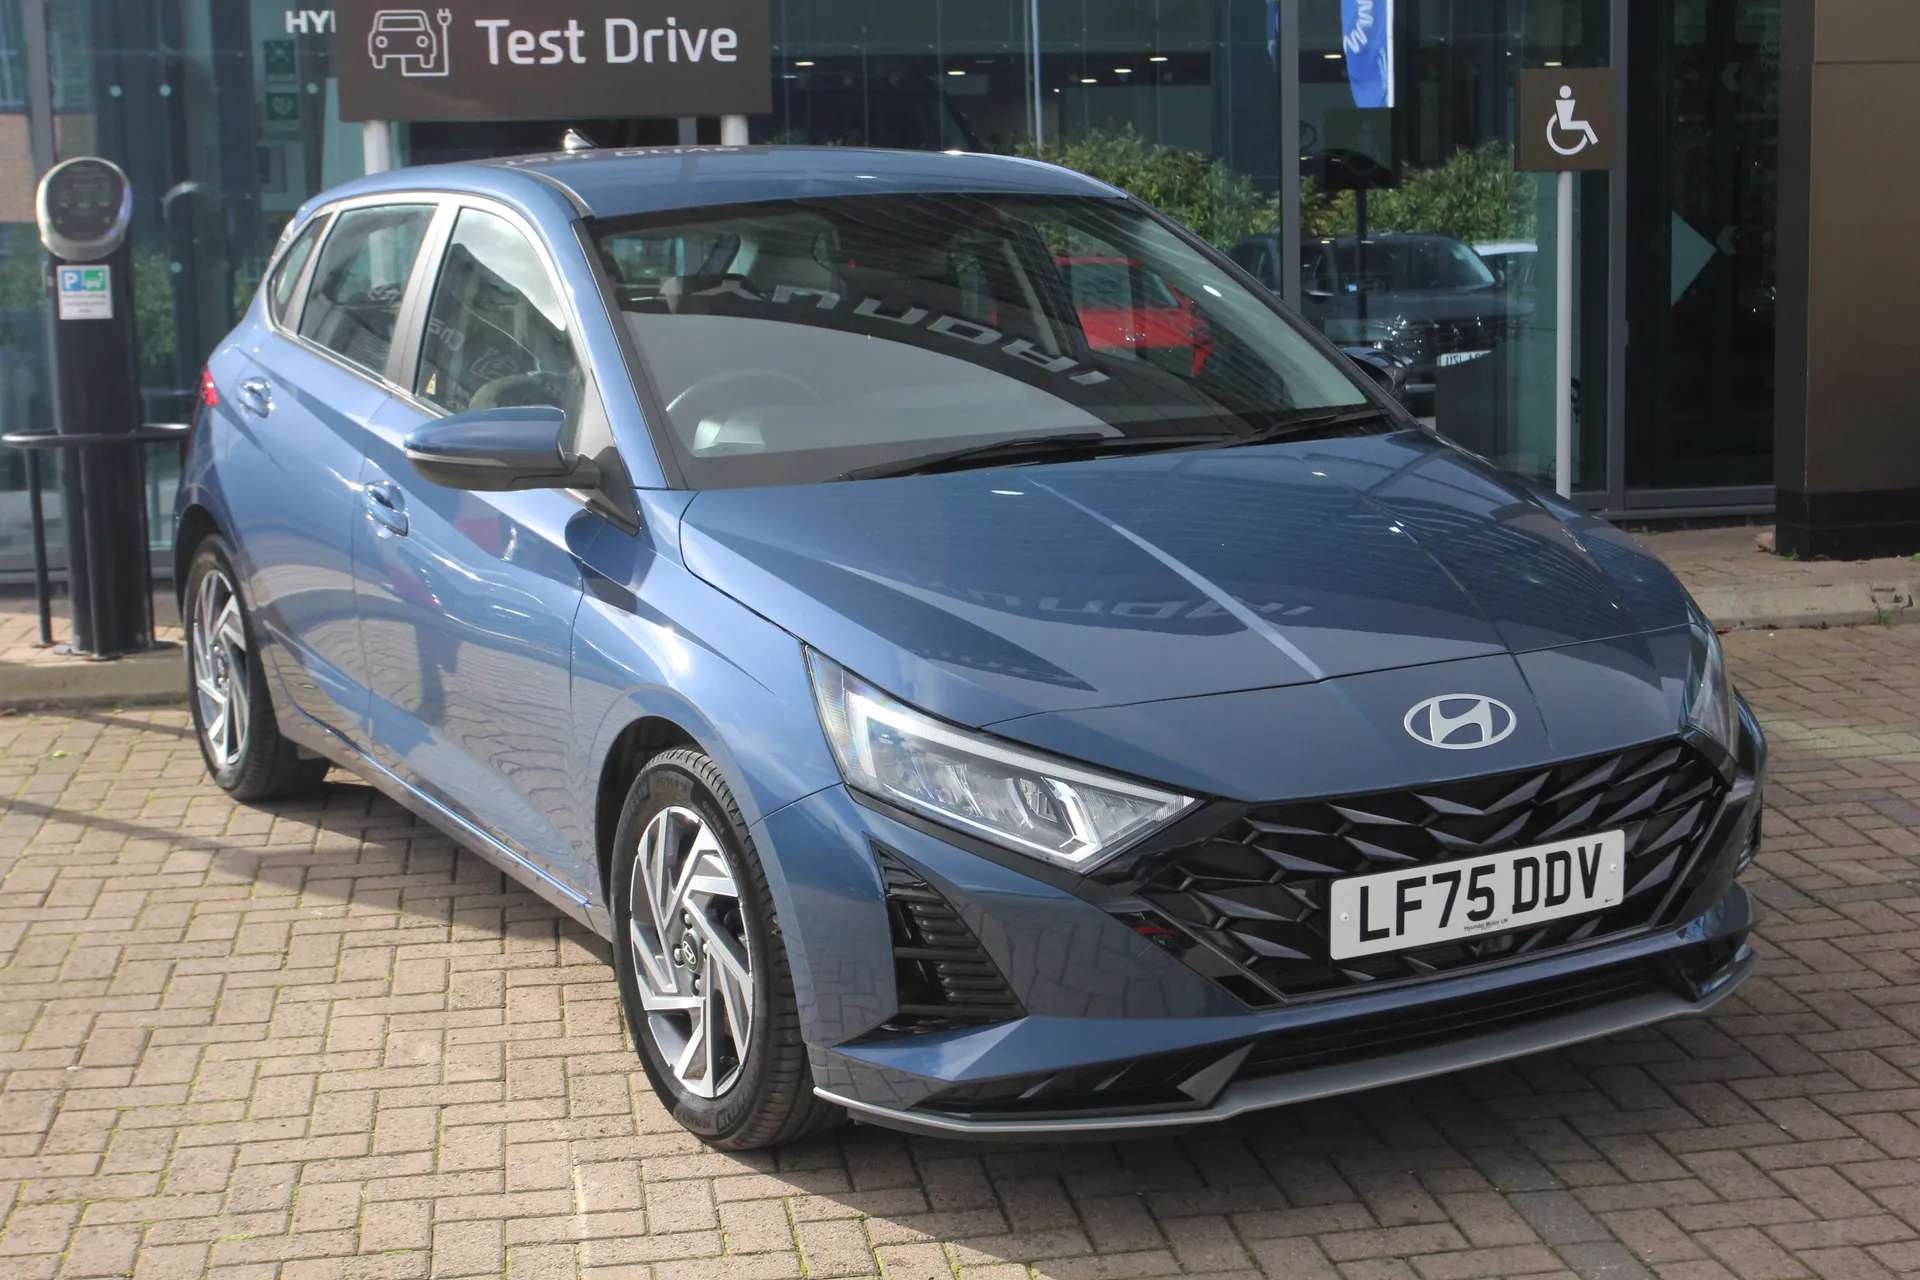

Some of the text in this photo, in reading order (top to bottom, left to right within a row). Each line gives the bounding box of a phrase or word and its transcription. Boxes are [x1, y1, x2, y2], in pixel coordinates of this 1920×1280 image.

[285, 10, 337, 34] HY
[474, 17, 738, 65] Test Drive
[1359, 842, 1603, 942] LF75 DDV
